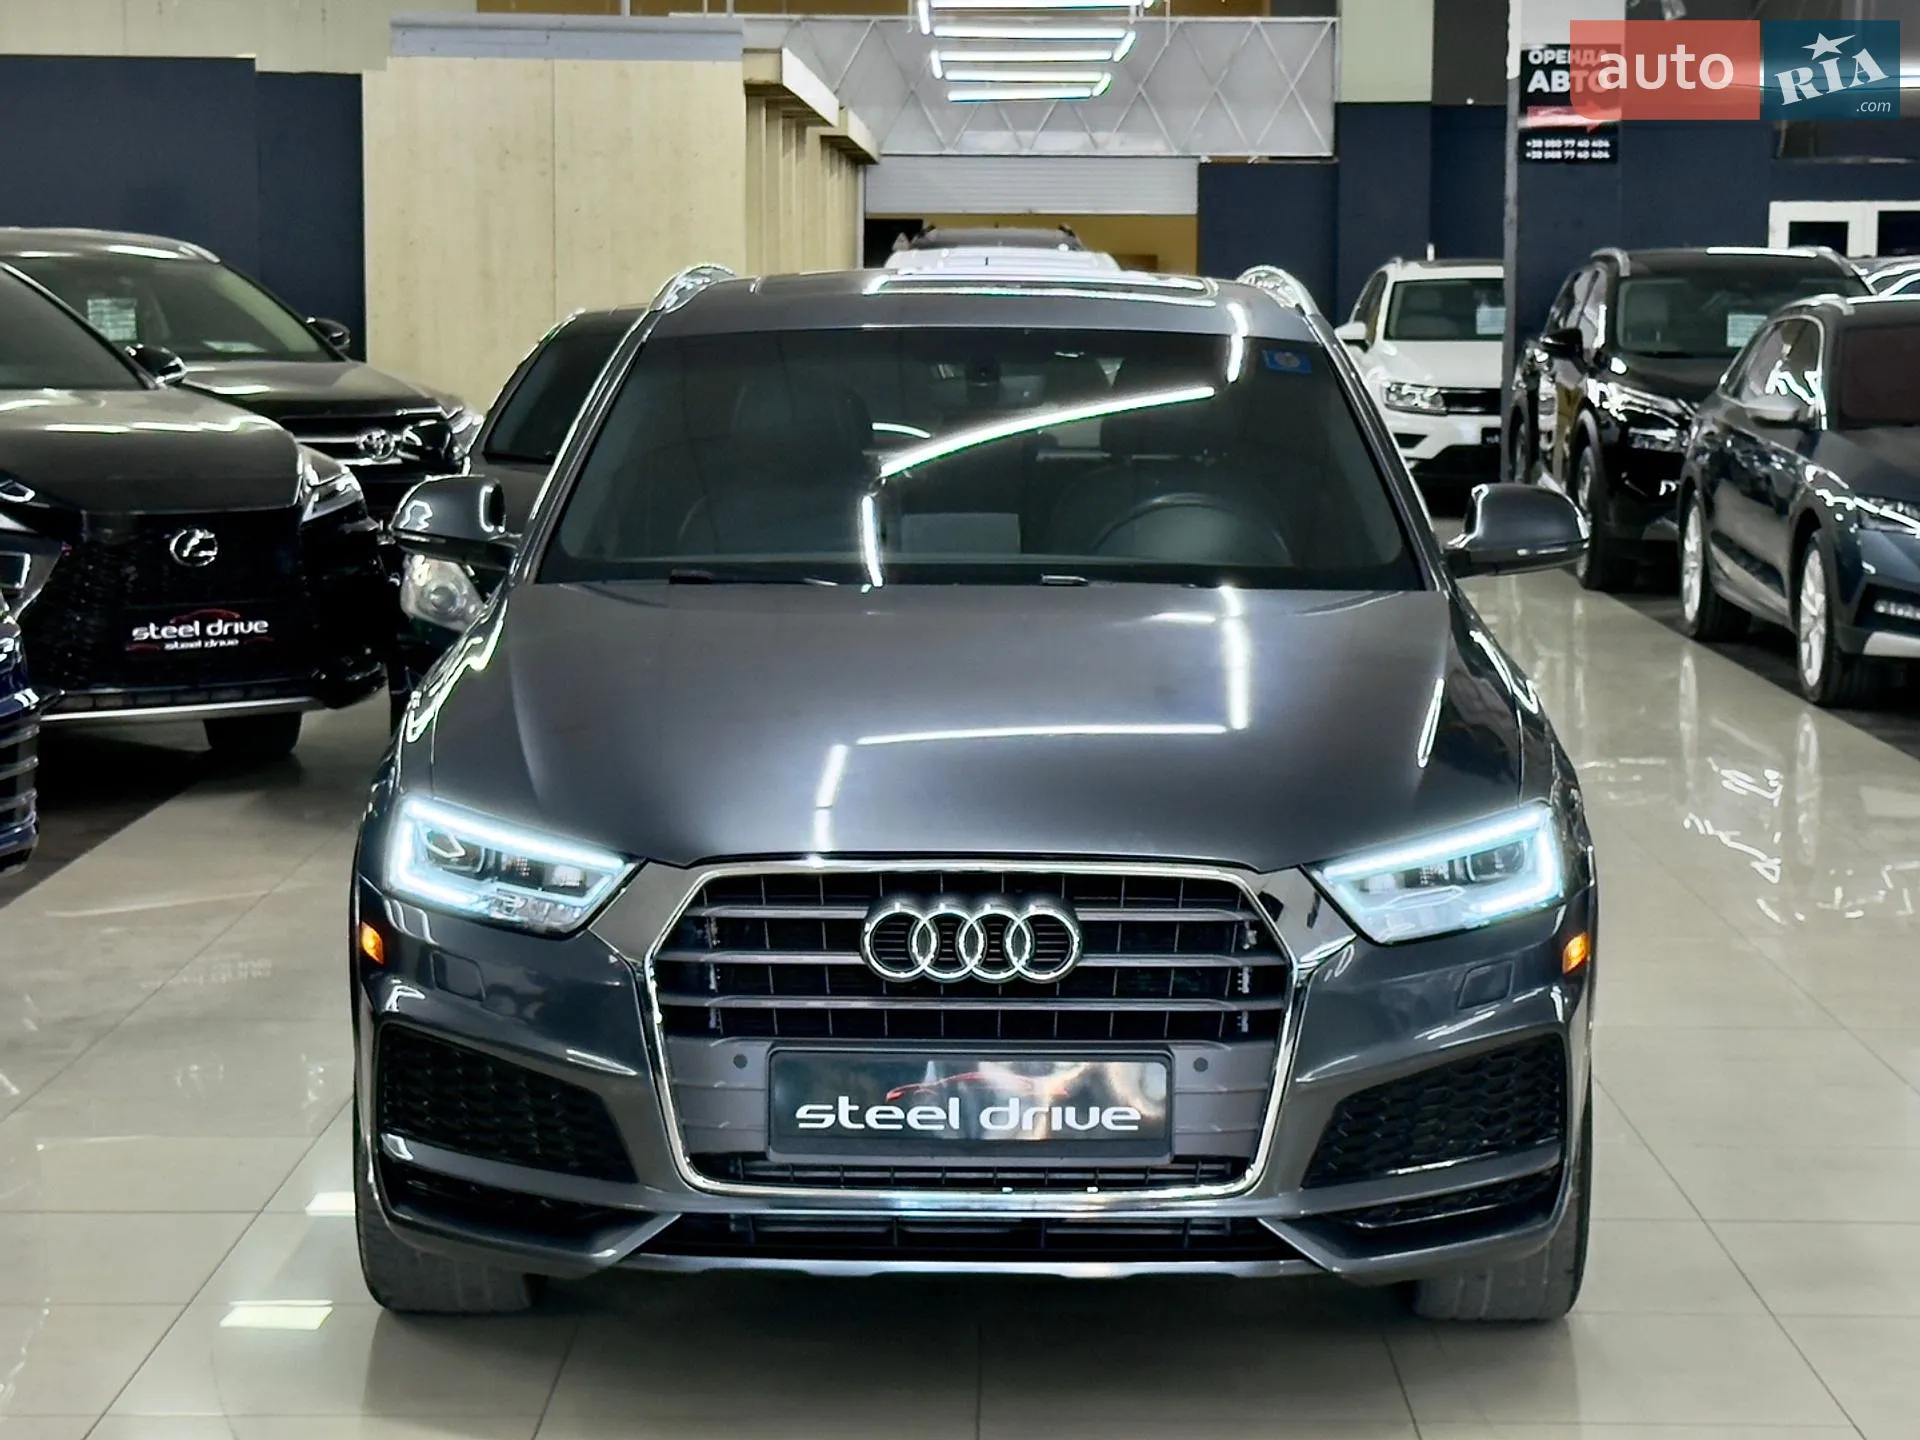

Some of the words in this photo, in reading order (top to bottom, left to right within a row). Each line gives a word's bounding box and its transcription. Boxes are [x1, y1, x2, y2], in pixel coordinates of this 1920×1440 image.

[1527, 69, 1610, 93] АВТО
[131, 620, 200, 641] steel
[206, 618, 269, 636] drive
[795, 1095, 960, 1131] steel
[978, 1096, 1141, 1131] drive
